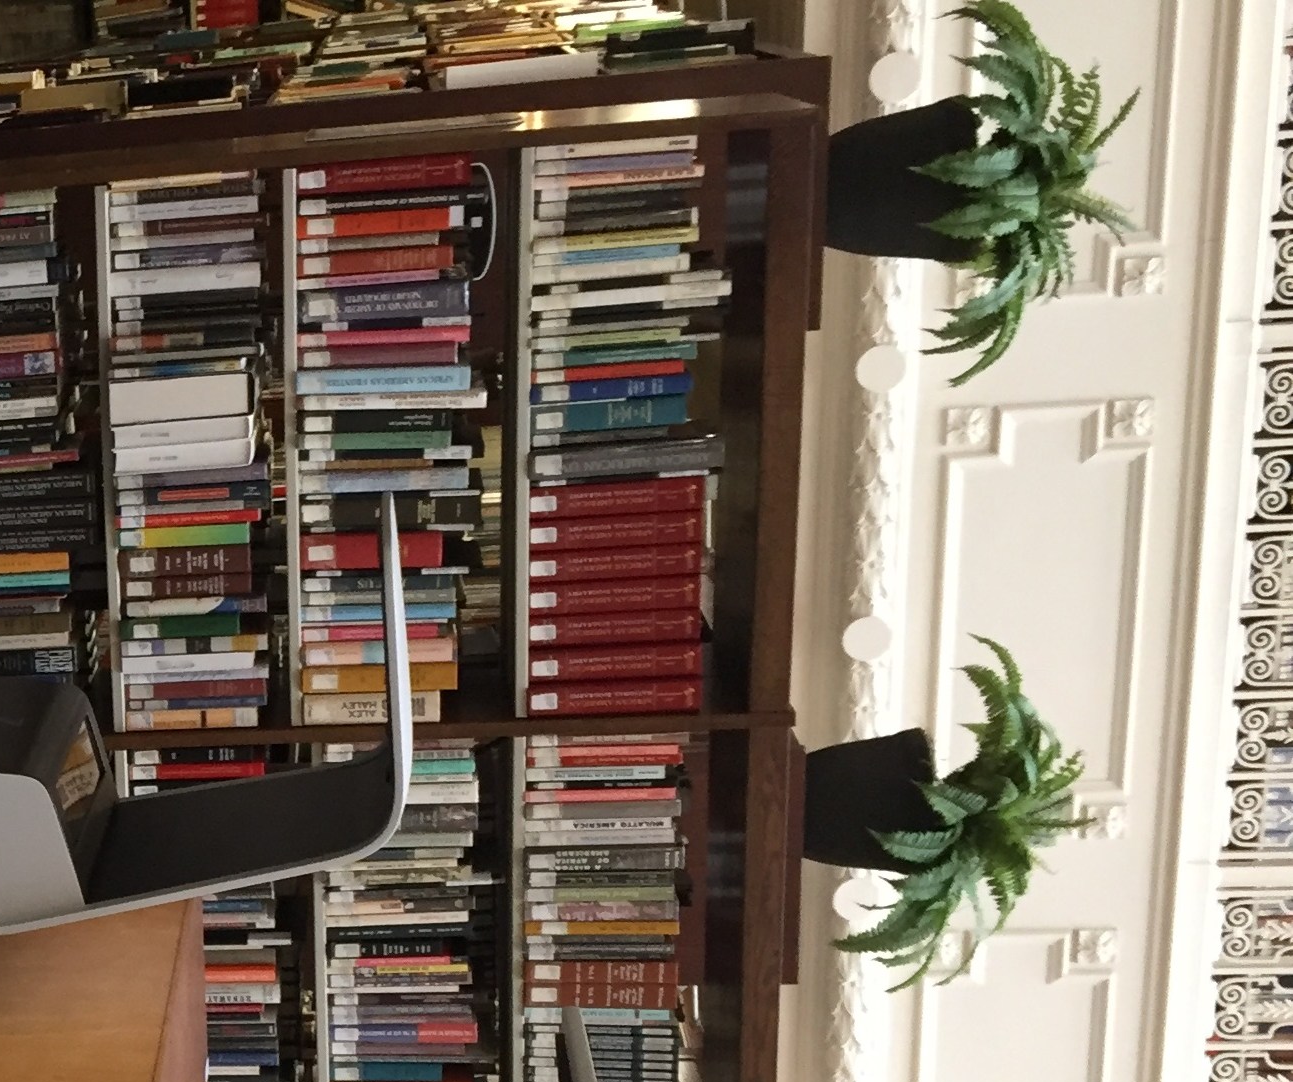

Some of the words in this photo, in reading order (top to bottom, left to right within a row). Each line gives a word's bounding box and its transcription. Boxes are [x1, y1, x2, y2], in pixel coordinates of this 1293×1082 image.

[341, 701, 377, 710] HALEY
[348, 709, 377, 718] ALEX
[620, 821, 664, 829] MULATTO
